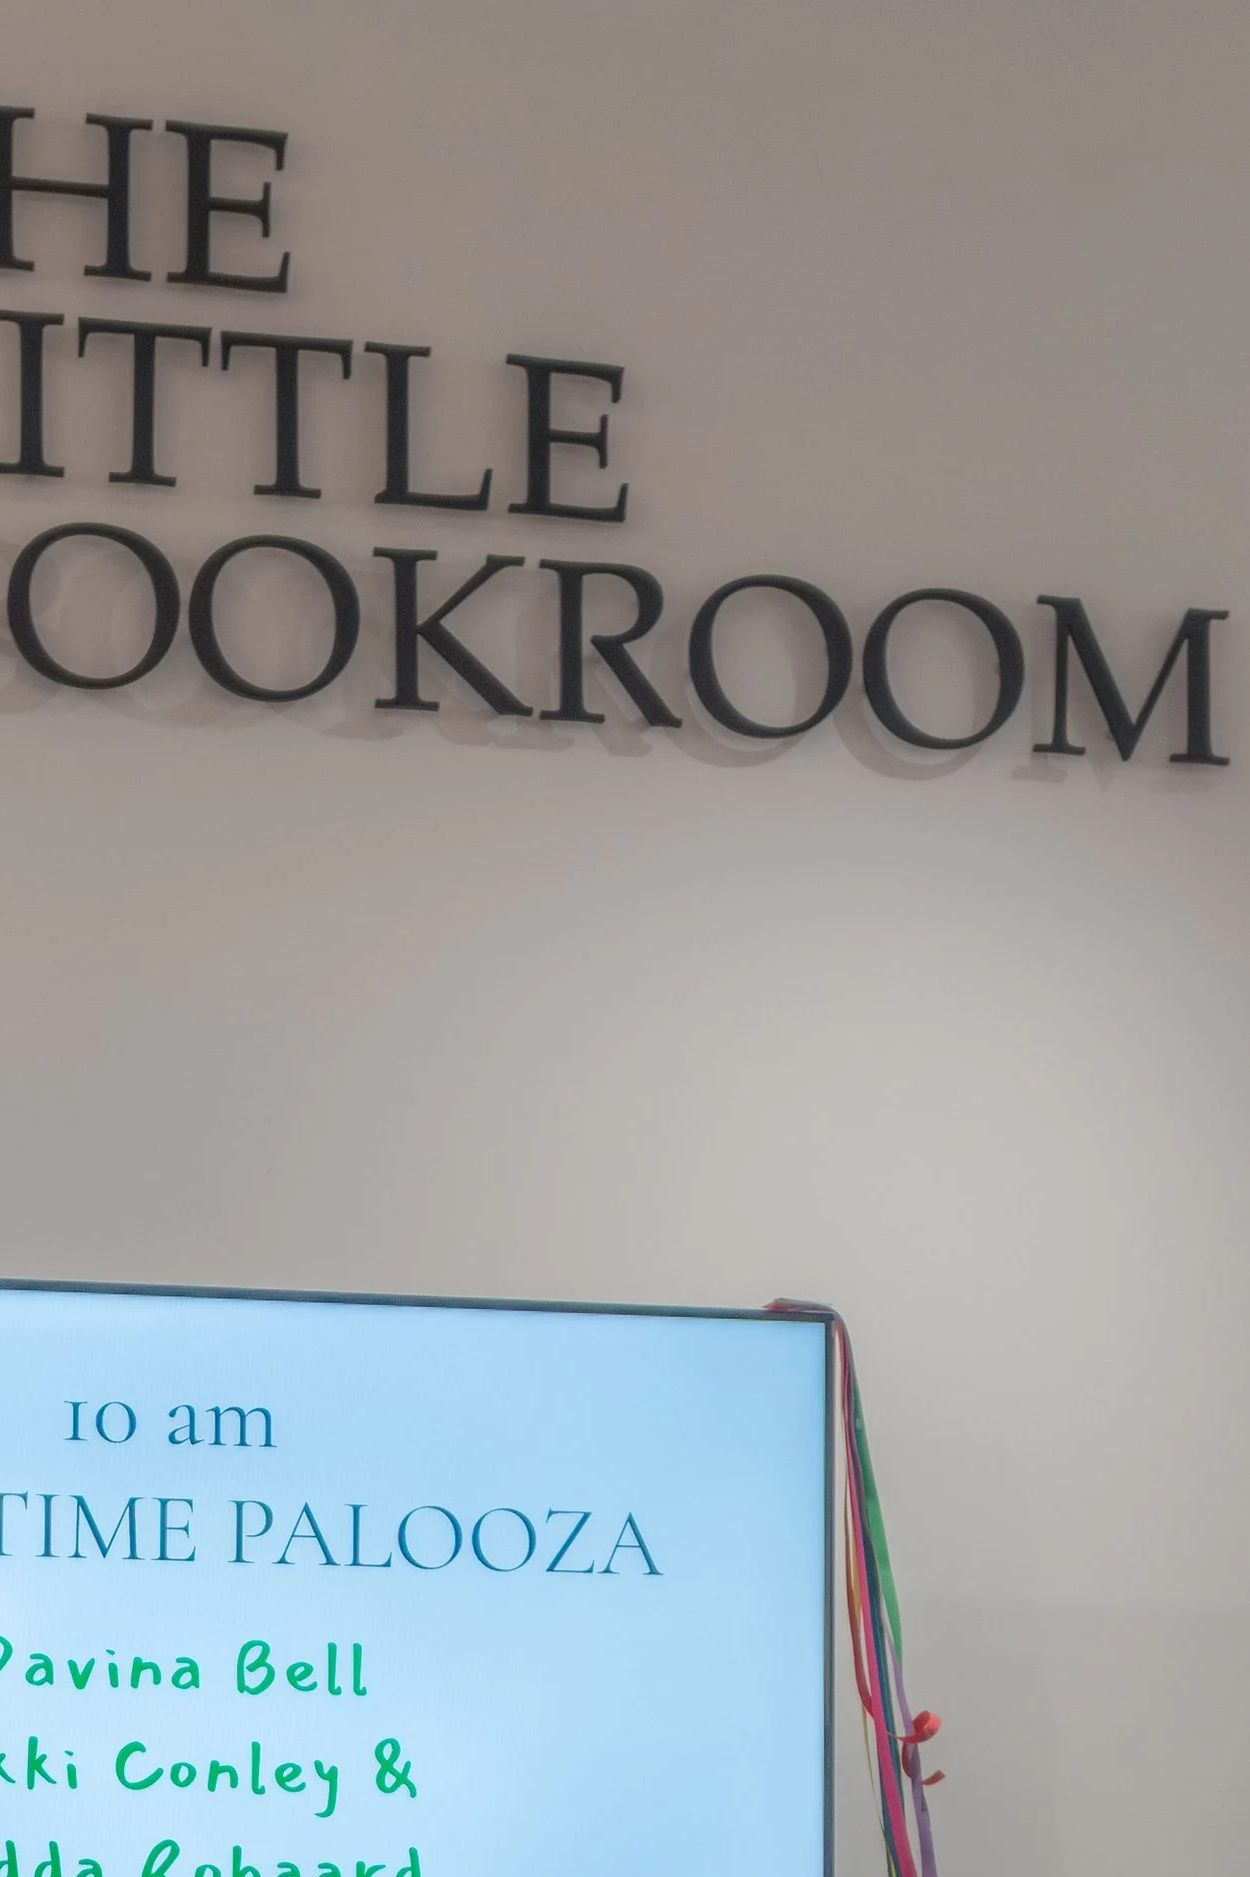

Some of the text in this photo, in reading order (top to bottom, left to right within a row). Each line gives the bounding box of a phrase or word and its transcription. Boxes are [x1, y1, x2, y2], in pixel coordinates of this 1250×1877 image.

[64, 1397, 278, 1449] 10 am
[228, 1498, 664, 1578] PALOOZA
[237, 1641, 369, 1697] Bell
[116, 1740, 340, 1818] Conley
[375, 1738, 417, 1798] &
